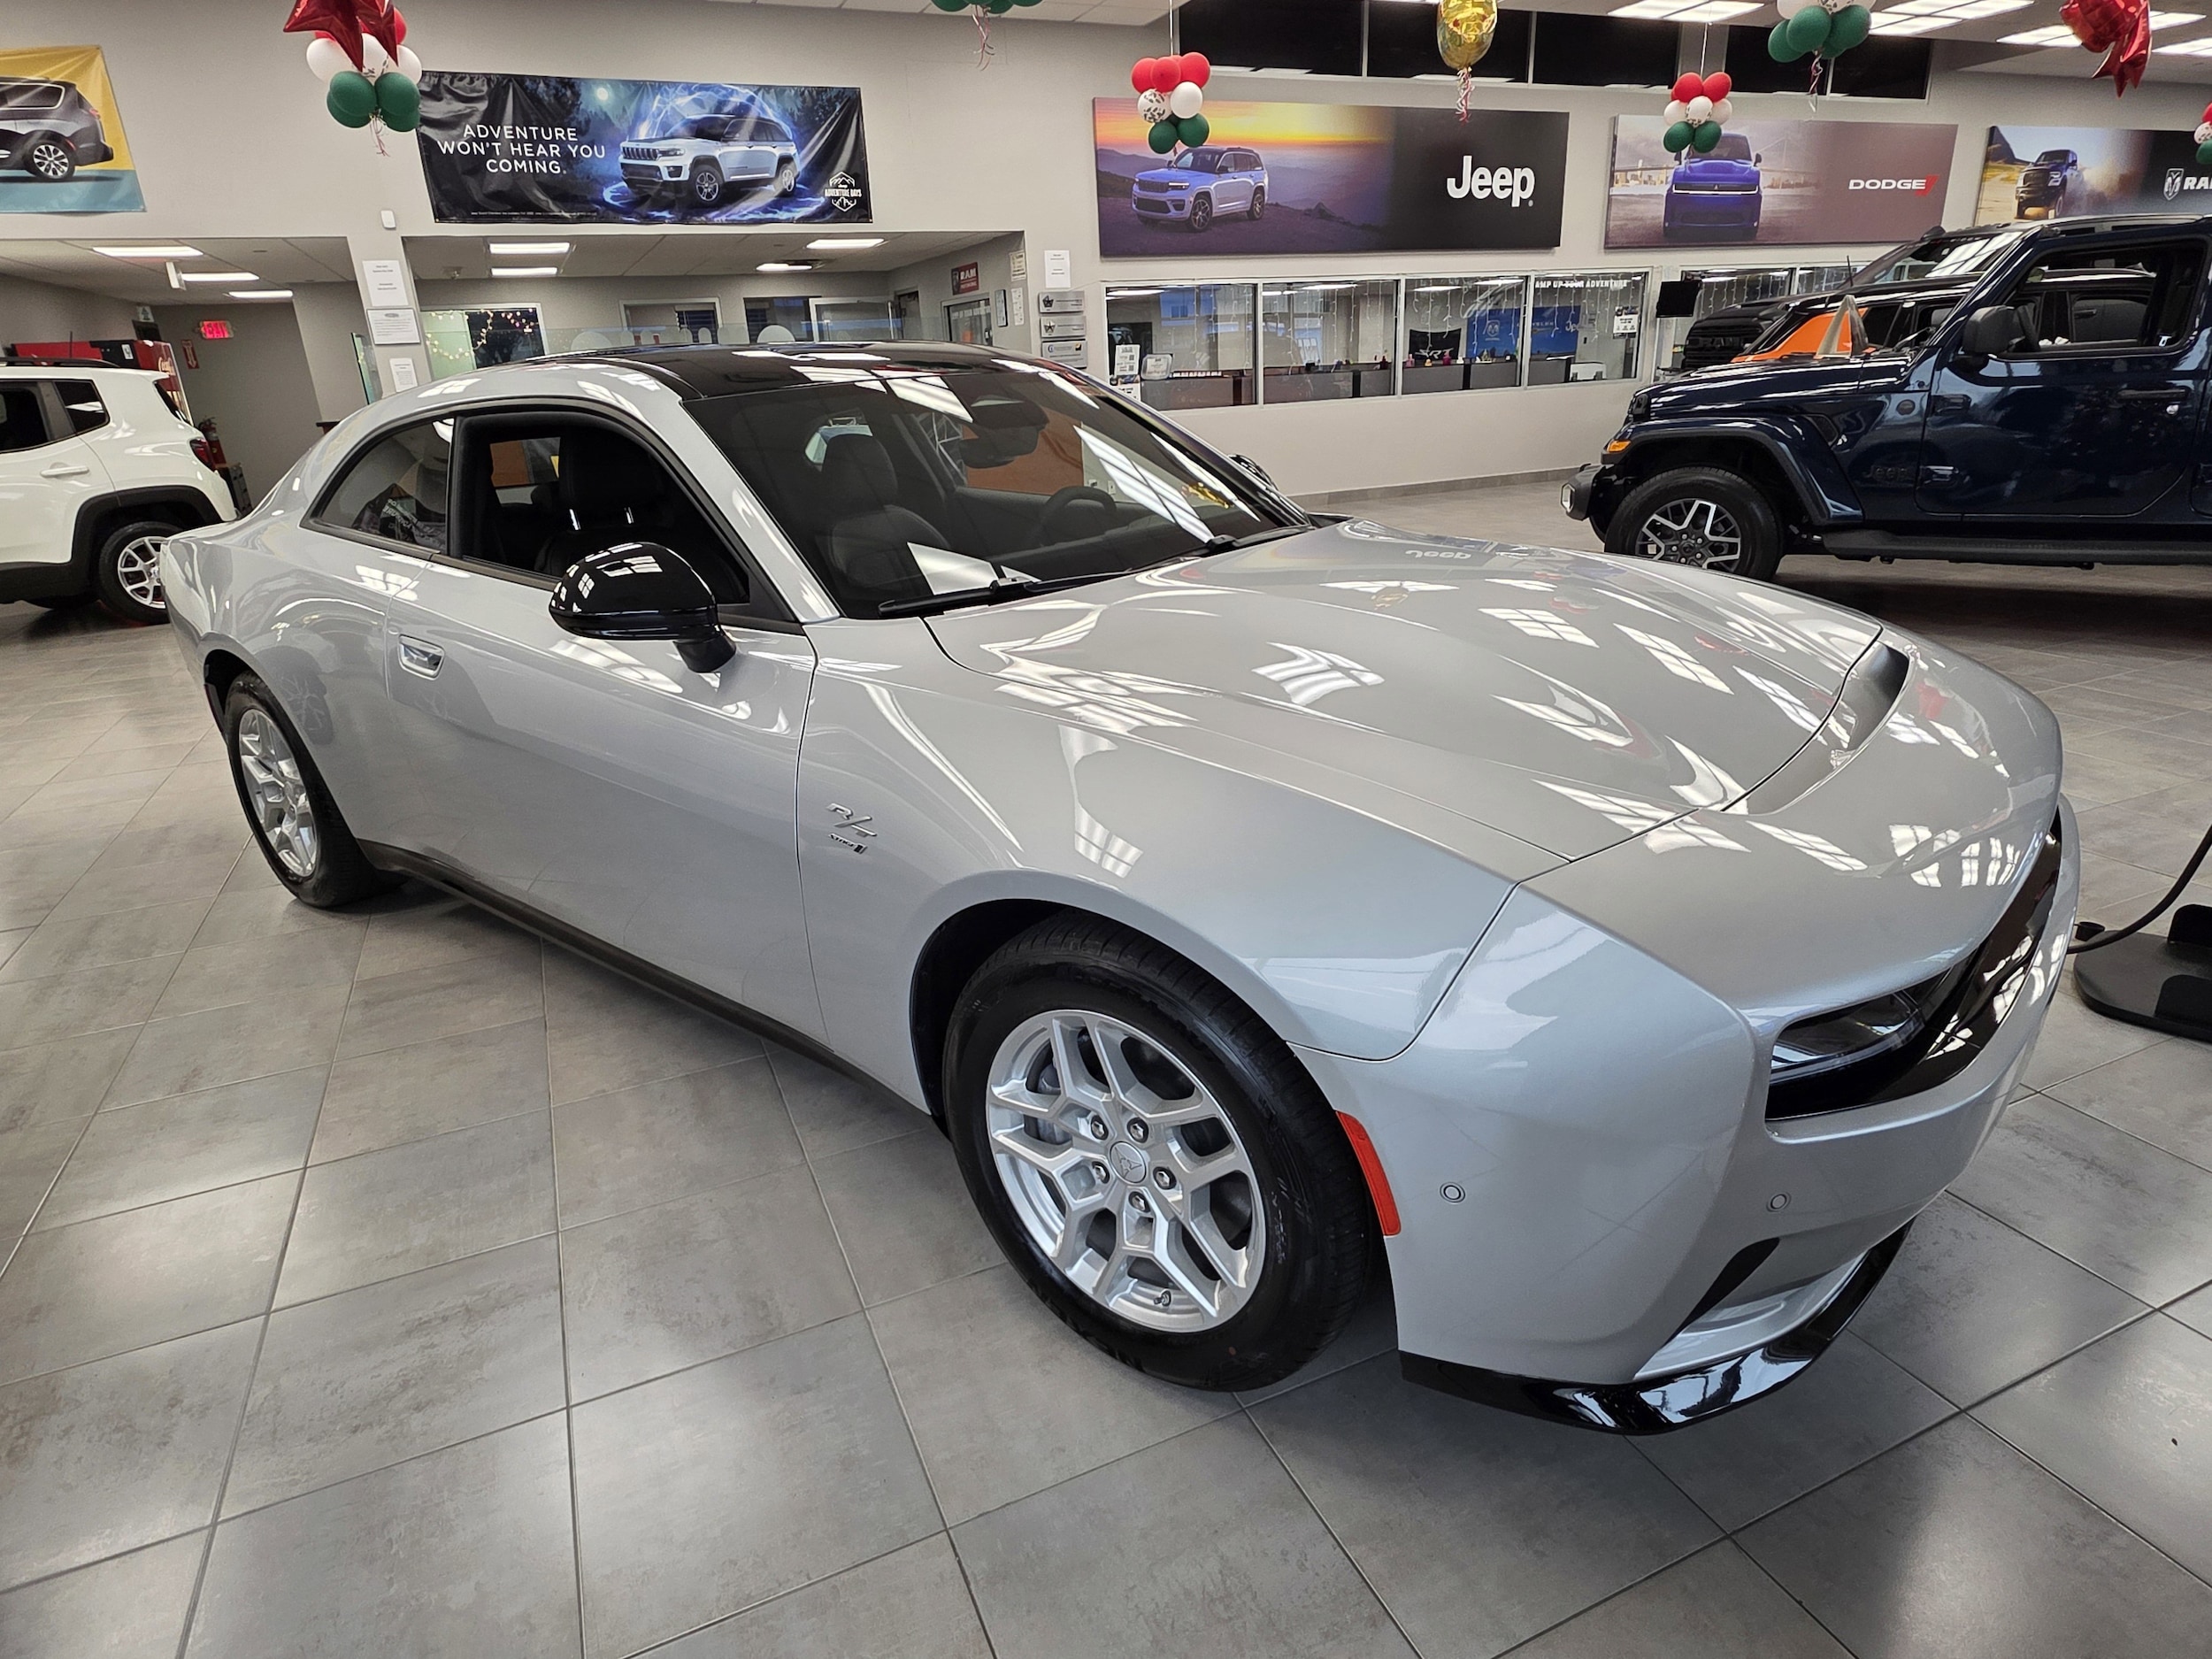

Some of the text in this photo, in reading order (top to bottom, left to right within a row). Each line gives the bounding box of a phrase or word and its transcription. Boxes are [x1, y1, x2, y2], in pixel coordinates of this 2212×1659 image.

[464, 124, 578, 142] ADVENTURE
[437, 140, 606, 158] WON'T HEAR YOU
[1447, 155, 1535, 208] Jeep
[1848, 179, 1927, 189] DODGE
[2183, 176, 2212, 190] RA
[960, 267, 977, 280] RAM
[826, 803, 878, 838] R/T
